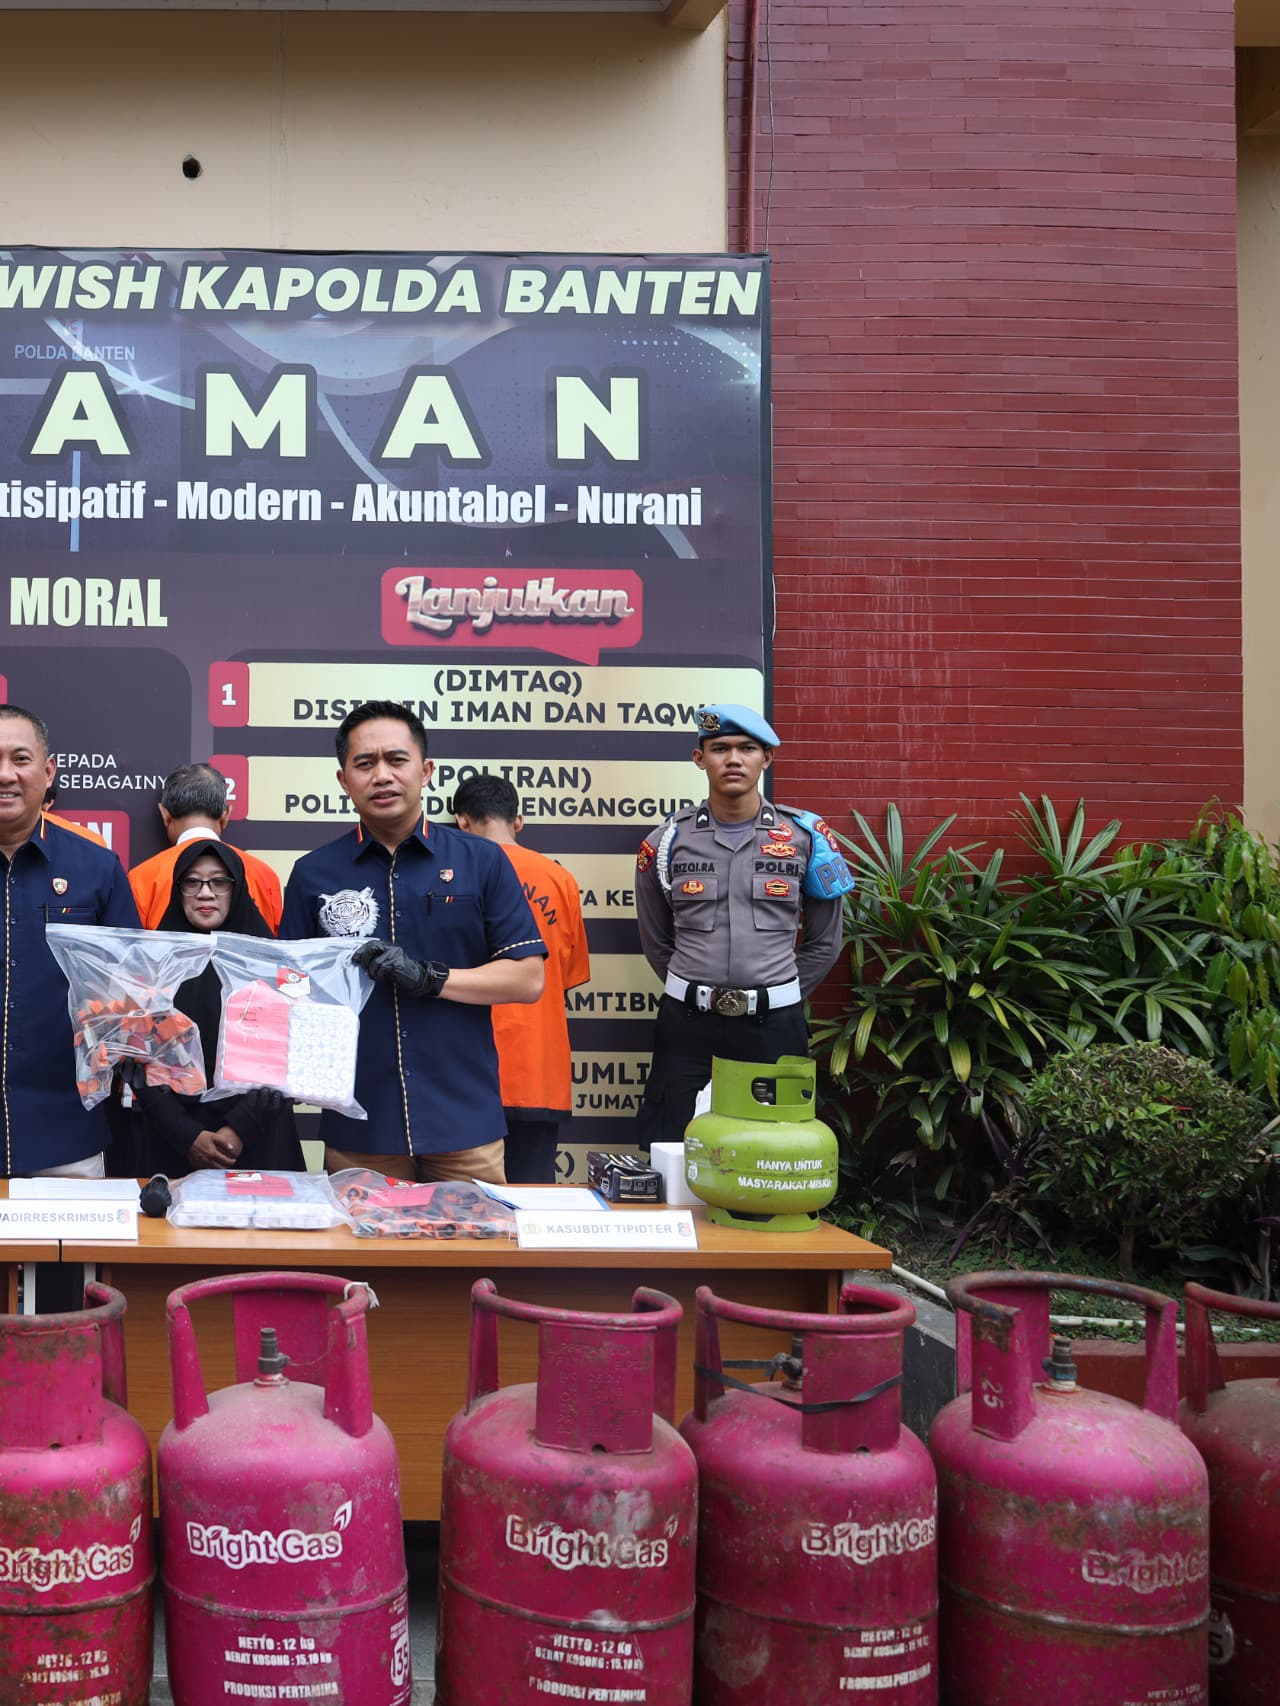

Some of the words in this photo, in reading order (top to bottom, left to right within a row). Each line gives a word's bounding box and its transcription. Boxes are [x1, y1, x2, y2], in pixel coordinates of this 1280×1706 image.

[178, 266, 483, 315] KAPOLDA
[504, 269, 761, 317] BANTEN
[14, 345, 67, 361] POLDA
[30, 370, 640, 462] AMAN
[177, 482, 323, 521] Modern
[352, 484, 545, 525] Akuntabel
[577, 486, 702, 527] Nurani
[10, 577, 168, 628] MORAL
[394, 576, 636, 632] Lanjutkan
[221, 683, 237, 706] 1
[433, 669, 583, 698] (DIMTAQ)
[450, 701, 532, 723] IMAN
[544, 702, 613, 724] DAN
[617, 703, 698, 726] TAQW
[50, 754, 117, 769] EPADA
[59, 774, 169, 790] SEBAGAINY
[285, 793, 360, 815] POLI
[754, 861, 800, 876] POLRI
[756, 1159, 792, 1171] HANYA
[794, 1158, 823, 1171] UNTUK
[737, 1176, 808, 1191] MASYARAKAT
[546, 1224, 613, 1235] KASUBDIT
[616, 1223, 673, 1234] TIPIDTER
[187, 1521, 278, 1570] Bright
[276, 1528, 343, 1563] Gas
[801, 1522, 902, 1565] Bright
[86, 1543, 135, 1581] Gas
[238, 1635, 275, 1650] NETTO
[282, 1637, 297, 1650] 12
[553, 1633, 593, 1652] NETTO
[600, 1640, 615, 1654] 12
[224, 1649, 251, 1664] BERAT
[252, 1653, 290, 1666] KOSONG
[223, 1680, 277, 1699] PRODUKSI
[278, 1681, 339, 1699] PERTAMINA
